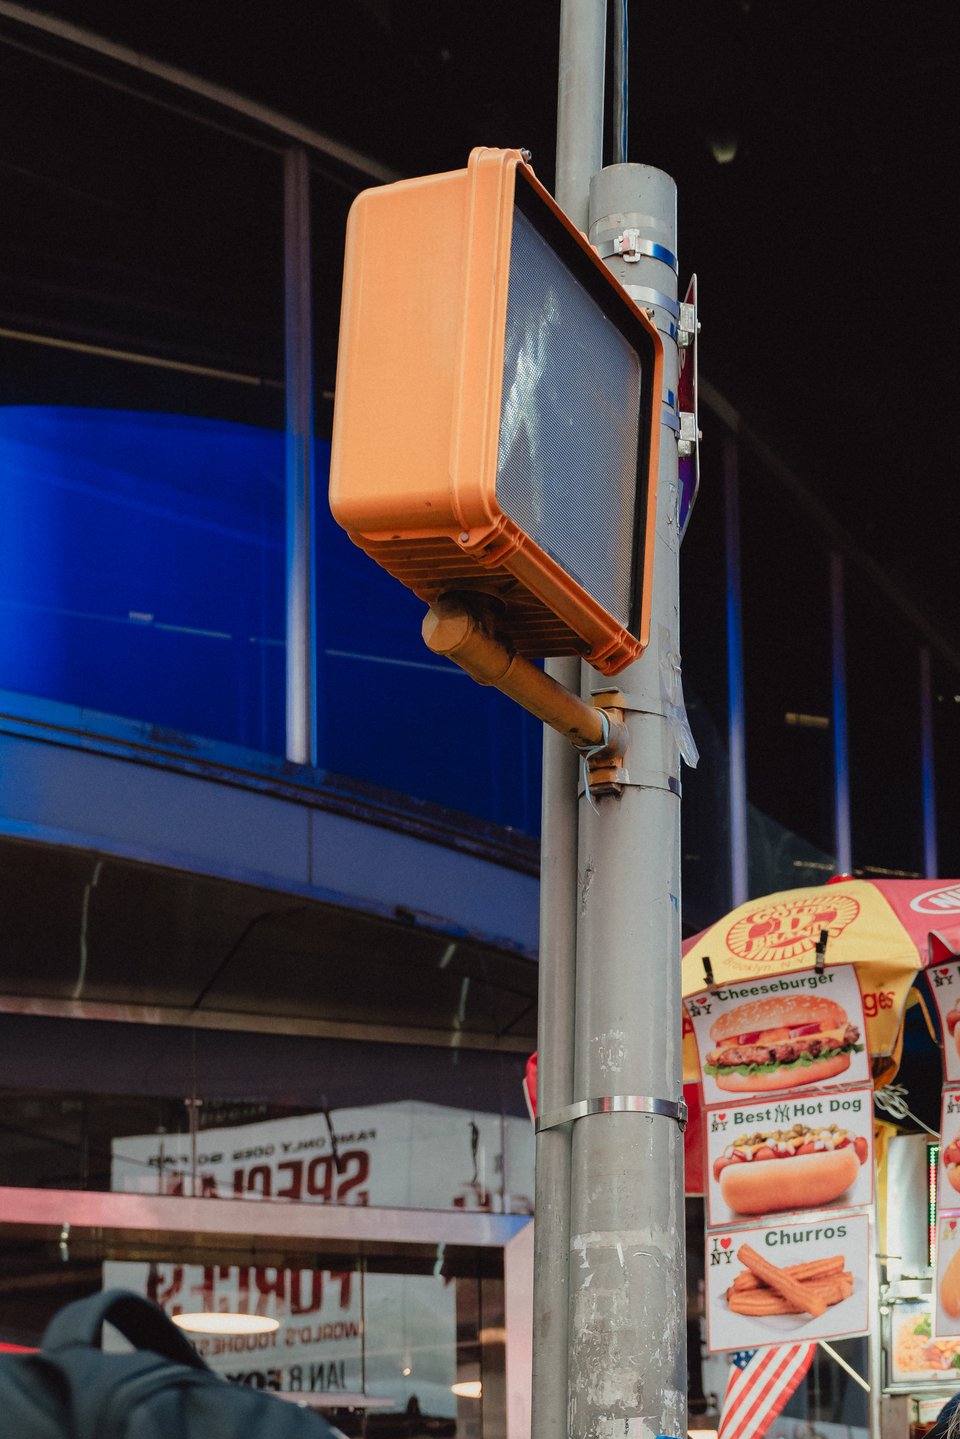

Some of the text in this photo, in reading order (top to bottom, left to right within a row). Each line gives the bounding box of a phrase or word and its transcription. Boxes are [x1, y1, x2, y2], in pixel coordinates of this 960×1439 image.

[715, 972, 835, 1002] Cheeseburger
[733, 1109, 771, 1125] Best
[793, 1101, 824, 1117] Hot
[829, 1098, 862, 1113] Dog
[711, 1120, 729, 1133] NY
[713, 1238, 718, 1252] I
[764, 1225, 847, 1247] Churros
[710, 1250, 735, 1266] NY
